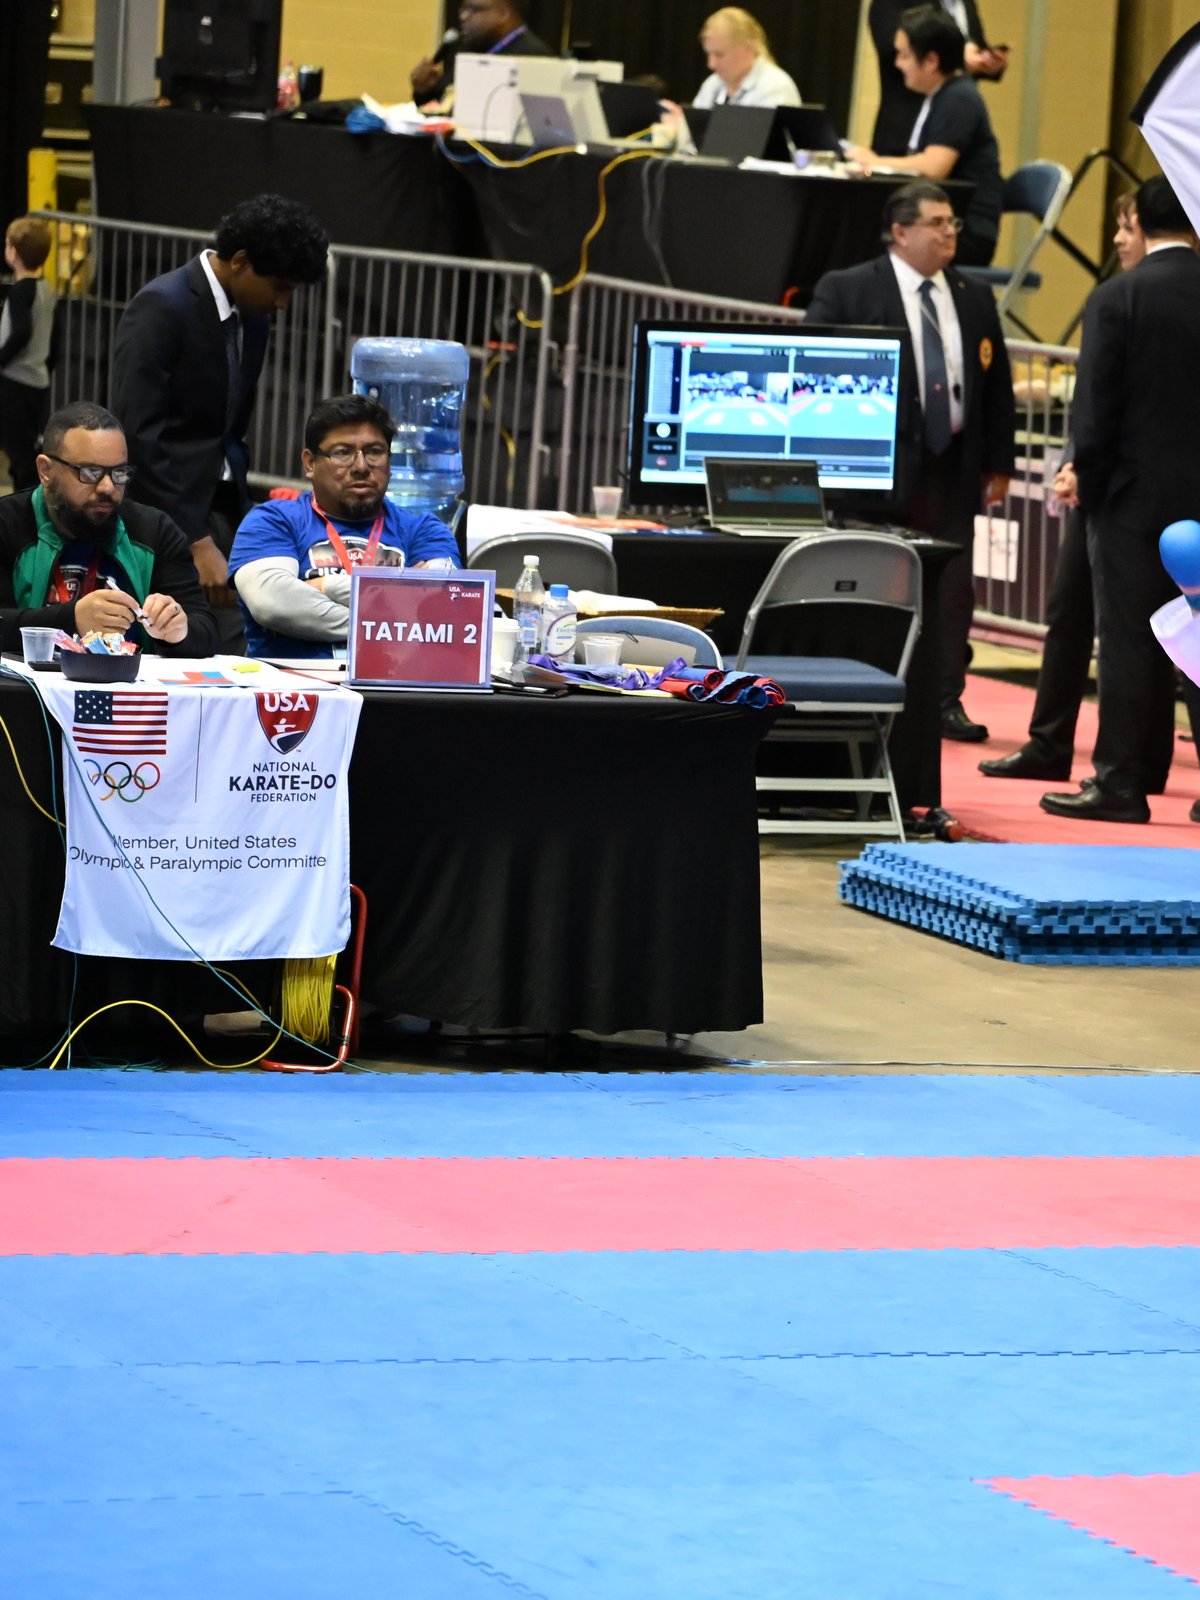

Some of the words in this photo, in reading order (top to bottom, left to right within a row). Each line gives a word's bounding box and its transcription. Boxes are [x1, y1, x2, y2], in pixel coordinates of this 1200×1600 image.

[361, 621, 453, 644] TATAMI
[463, 623, 477, 644] 2
[263, 692, 311, 713] USA
[253, 761, 317, 773] NATIONAL
[229, 774, 337, 791] KARATE-DO
[250, 793, 317, 803] FEDERATION
[185, 836, 240, 850] United
[244, 835, 297, 849] States
[134, 856, 145, 870] &
[150, 856, 242, 873] Paralympic
